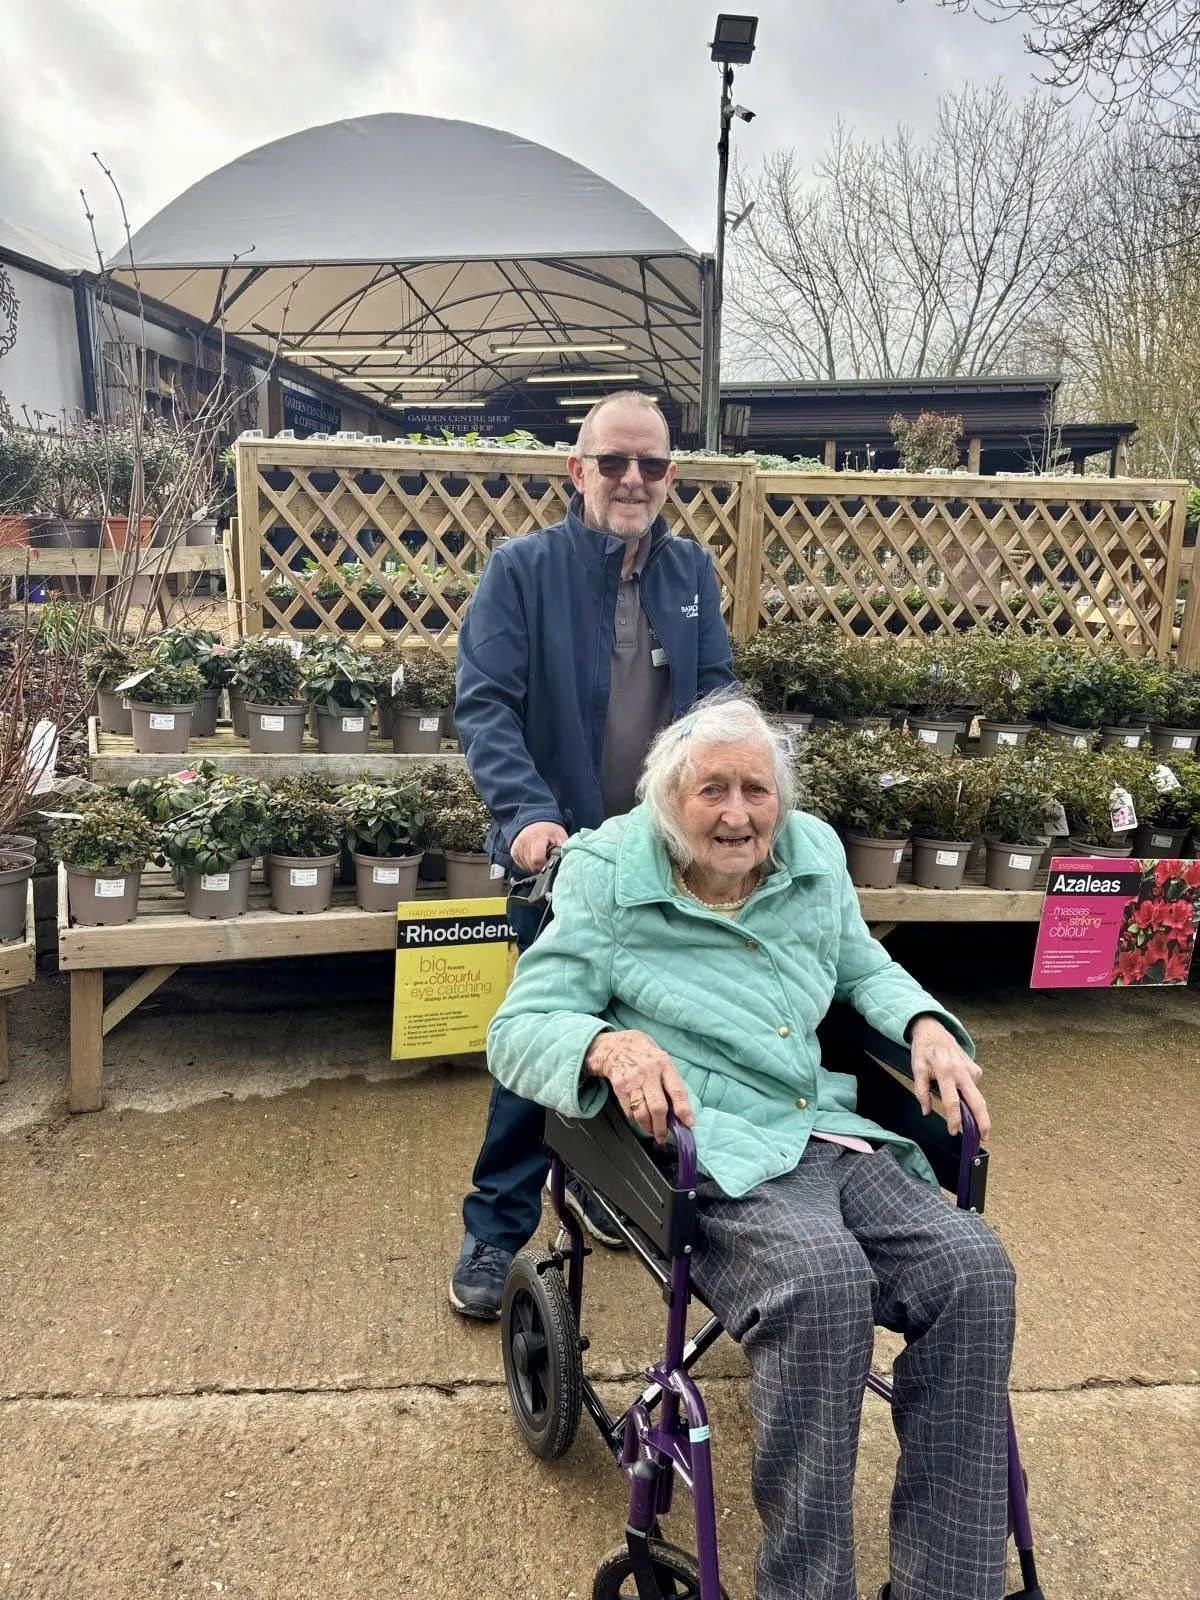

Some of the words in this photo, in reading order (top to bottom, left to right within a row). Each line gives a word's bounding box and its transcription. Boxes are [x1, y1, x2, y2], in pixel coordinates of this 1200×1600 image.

[407, 414, 447, 422] GARDEN
[448, 414, 486, 422] CENTRE
[487, 415, 510, 423] SHOP
[434, 424, 469, 432] COFFEE
[471, 424, 494, 432] SHOP
[1052, 874, 1121, 893] Azaleas
[408, 908, 437, 918] HARDY
[438, 907, 469, 917] HYBRID
[1053, 906, 1090, 916] masses
[1069, 915, 1102, 928] striking
[1049, 924, 1089, 937] colour
[419, 955, 447, 975] big
[428, 970, 481, 985] colourful
[410, 986, 434, 1000] eye
[437, 981, 492, 996] catching
